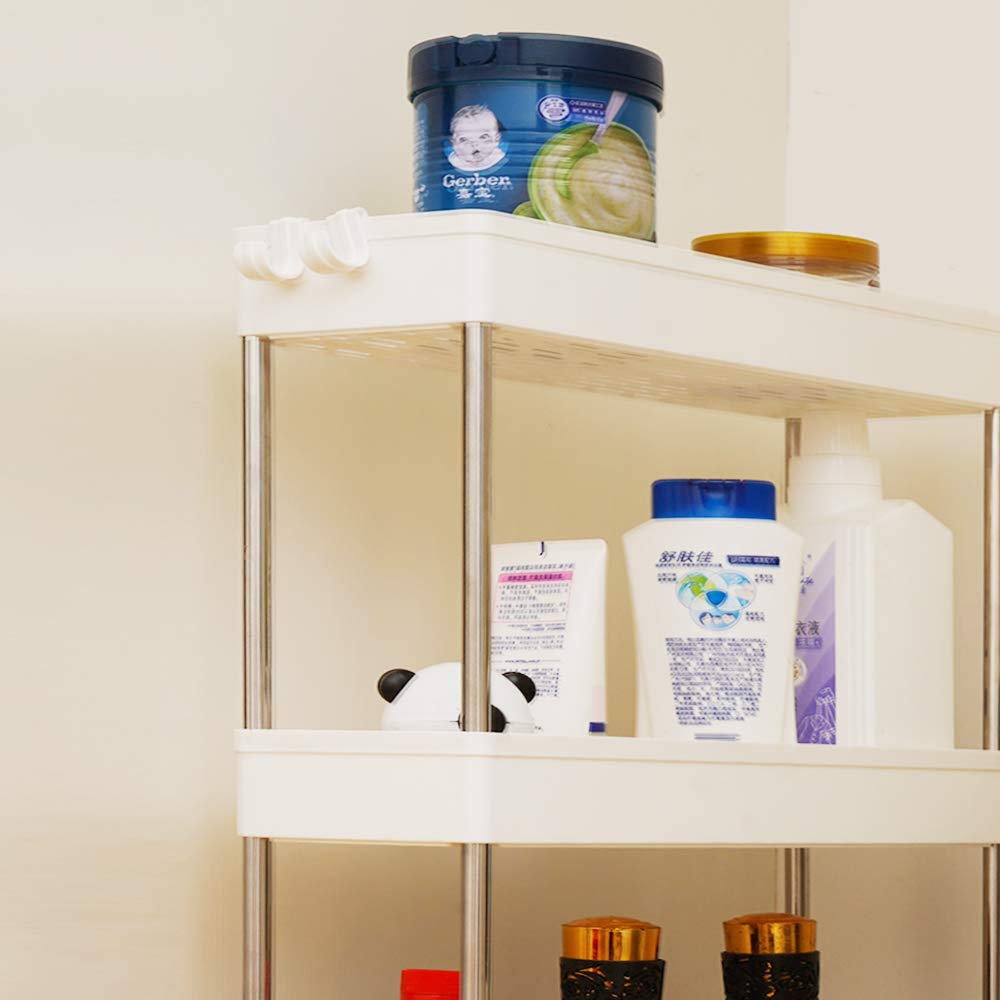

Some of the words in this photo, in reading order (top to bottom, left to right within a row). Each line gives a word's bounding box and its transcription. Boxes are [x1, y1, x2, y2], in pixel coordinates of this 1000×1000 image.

[442, 172, 511, 188] Gerber
[659, 550, 714, 563] 舒肤佳
